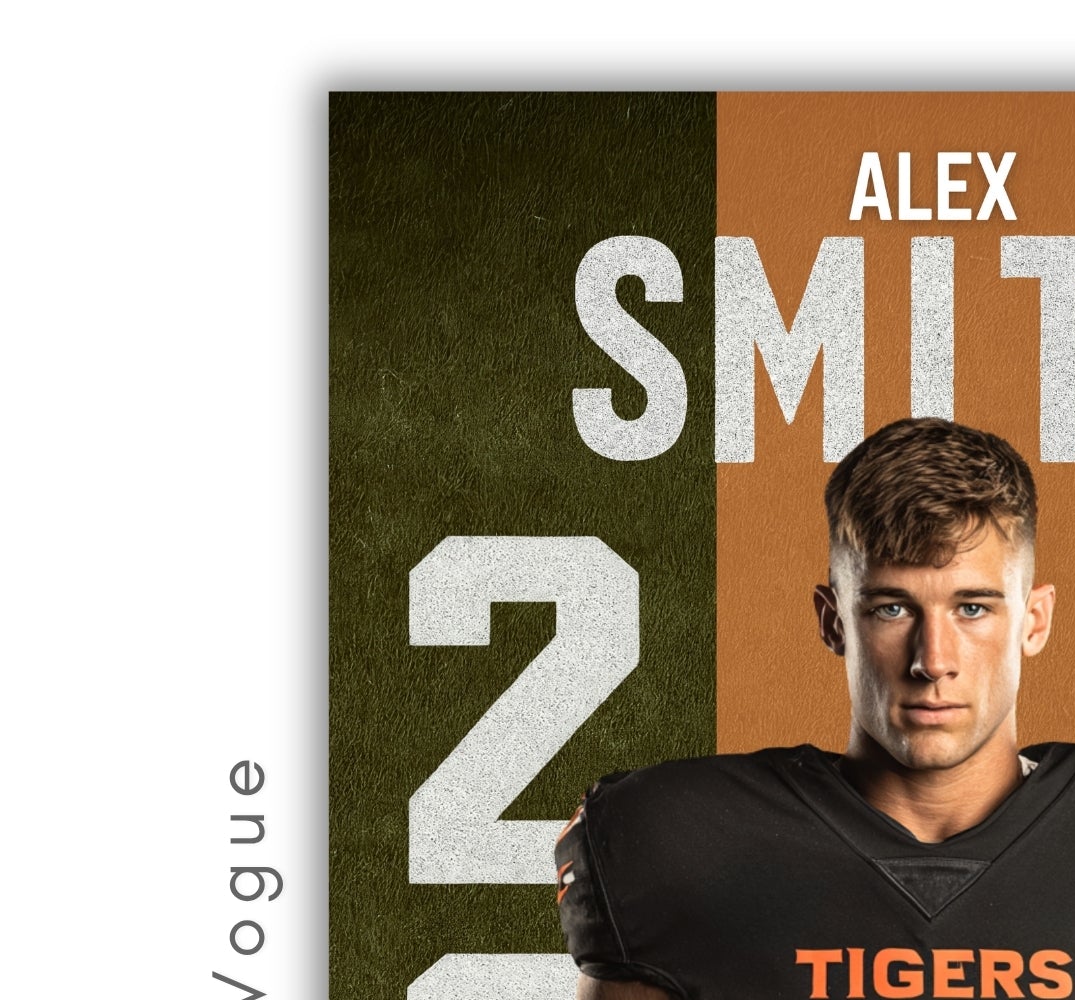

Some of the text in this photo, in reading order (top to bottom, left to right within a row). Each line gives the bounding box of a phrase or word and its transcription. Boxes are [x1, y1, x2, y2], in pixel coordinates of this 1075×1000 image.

[849, 151, 1018, 221] ALEX
[408, 535, 641, 885] 2
[796, 948, 1074, 1000] TIGERS
